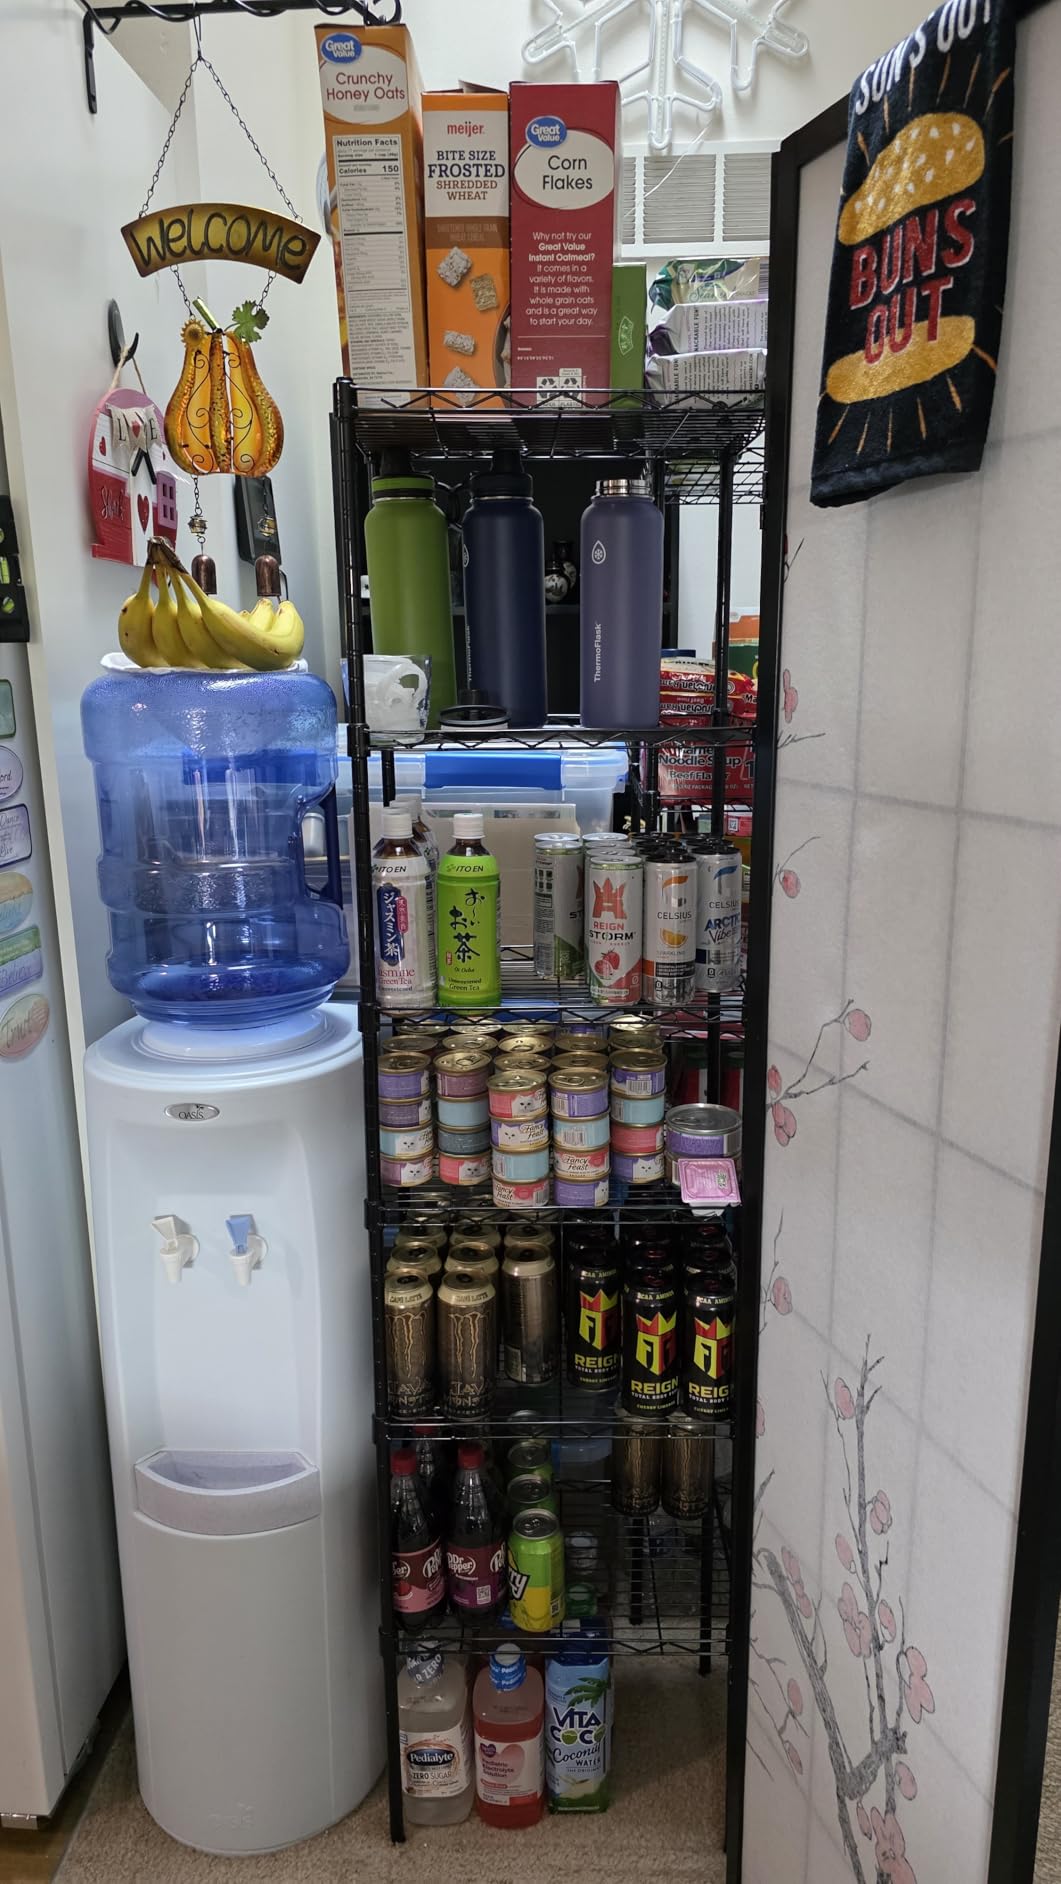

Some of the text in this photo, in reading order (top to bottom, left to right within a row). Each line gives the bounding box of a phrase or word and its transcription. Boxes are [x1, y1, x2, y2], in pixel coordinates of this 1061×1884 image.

[325, 40, 355, 51] Great
[333, 49, 355, 58] Value
[336, 72, 393, 87] Crunchy
[326, 87, 405, 103] Honey Oats
[447, 121, 484, 138] meijer
[530, 124, 560, 135] Great
[375, 138, 398, 146] Facts
[537, 133, 560, 143] Value
[437, 150, 496, 161] BITE SIZE
[383, 164, 399, 173] 150
[548, 155, 588, 171] Corn
[428, 163, 505, 178] FROSTED
[436, 180, 498, 190] SHREDDED
[542, 175, 593, 190] Flakes
[447, 190, 488, 201] WHEAT
[533, 232, 550, 241] Why
[551, 232, 565, 240] not
[566, 232, 576, 241] try
[538, 242, 586, 251] Great Value
[529, 253, 595, 262] Instant Oatmeal?
[851, 199, 976, 310] BUNS
[537, 264, 542, 272] It
[572, 264, 579, 272] in
[529, 274, 555, 283] variety
[557, 274, 565, 283] of
[573, 285, 590, 293] with
[530, 296, 594, 306] whole grain oats
[526, 306, 542, 315] and
[543, 306, 549, 315] is
[558, 307, 579, 316] great
[558, 318, 575, 327] your
[864, 276, 953, 365] OUT
[658, 753, 742, 768] Noodle Sup
[669, 770, 731, 780] Beef Flar
[657, 911, 692, 920] CELSIUS
[383, 892, 399, 957] ジャスミン茶
[593, 921, 625, 931] REIGN
[449, 905, 481, 963] お茶
[588, 929, 634, 941] STORM
[178, 1107, 204, 1120] OASIS
[563, 1156, 588, 1165] Fancy
[631, 1376, 679, 1395] REIGN
[453, 1554, 464, 1563] Dr
[421, 1654, 442, 1680] ZERO
[553, 1706, 602, 1729] VITA
[410, 1752, 454, 1764] Pedialyte
[483, 1763, 515, 1774] Electrolyte
[413, 1772, 430, 1780] ZERO
